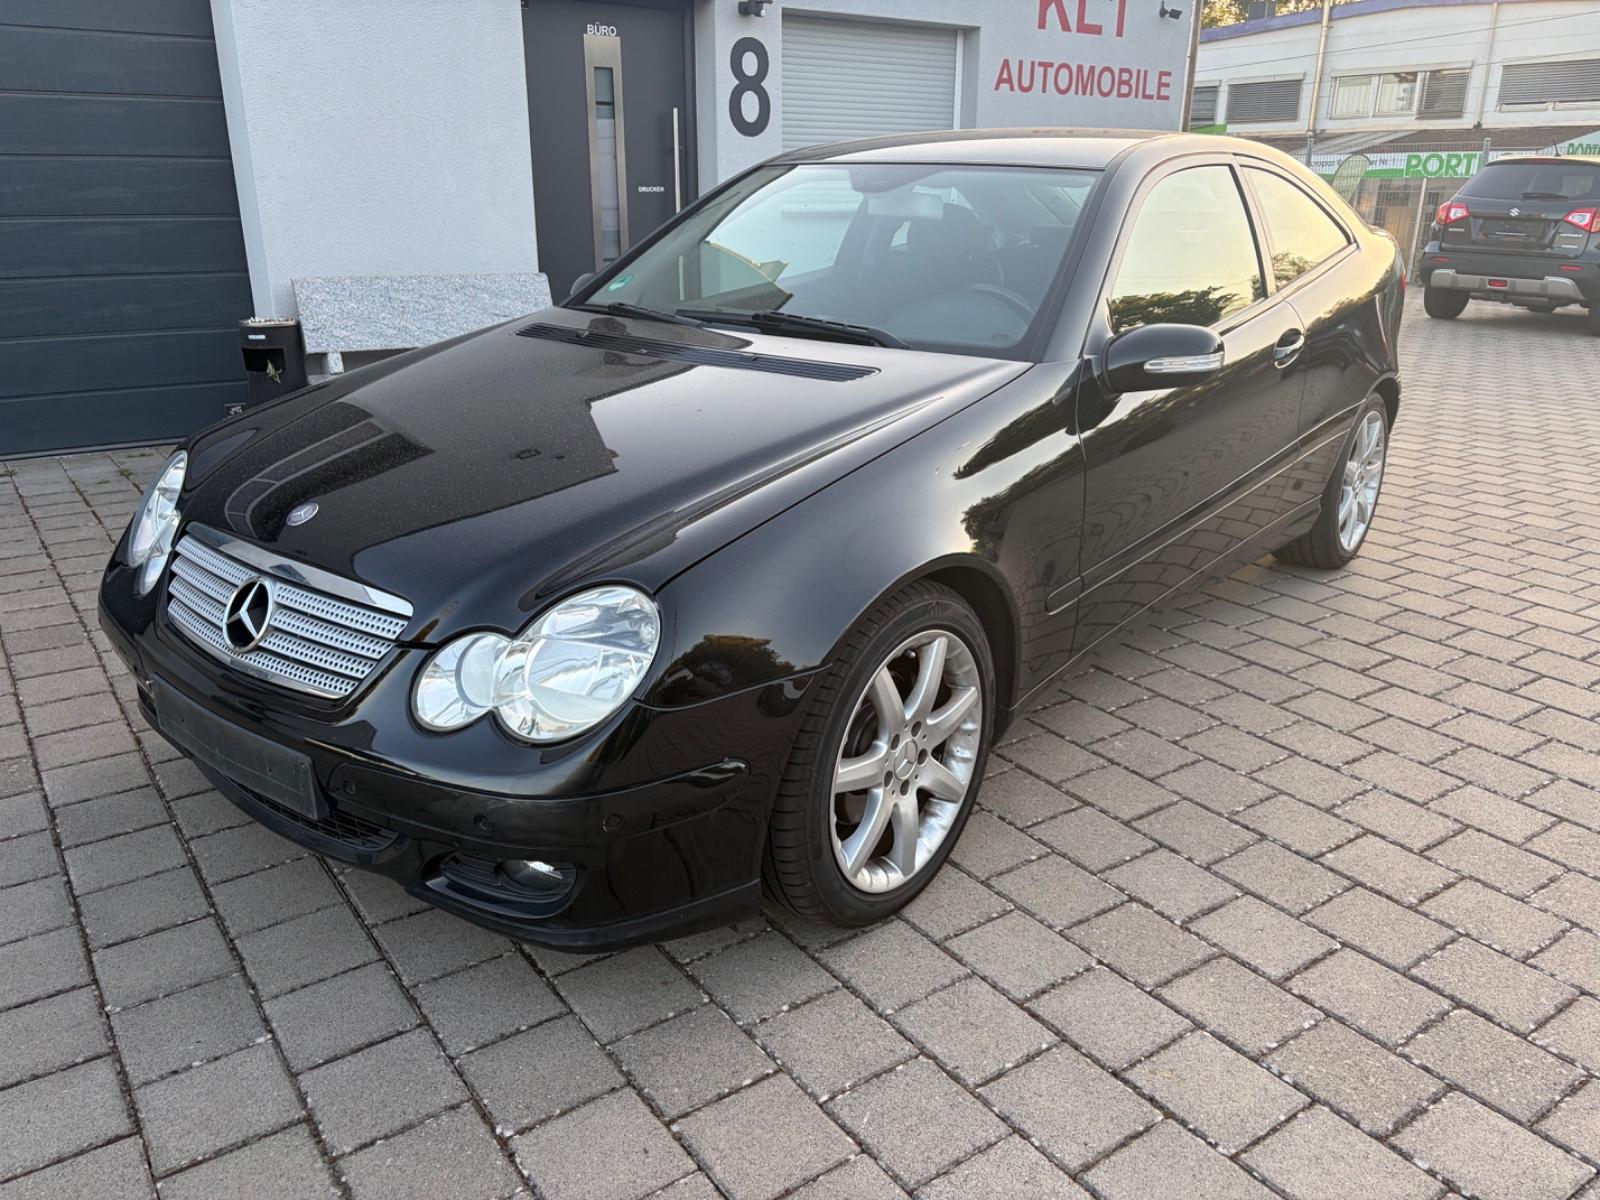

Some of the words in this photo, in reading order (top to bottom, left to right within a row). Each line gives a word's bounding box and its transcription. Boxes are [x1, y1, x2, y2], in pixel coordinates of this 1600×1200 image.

[586, 21, 617, 37] BÜRO
[729, 36, 771, 137] 8
[994, 58, 1172, 101] AUTOMOBILE
